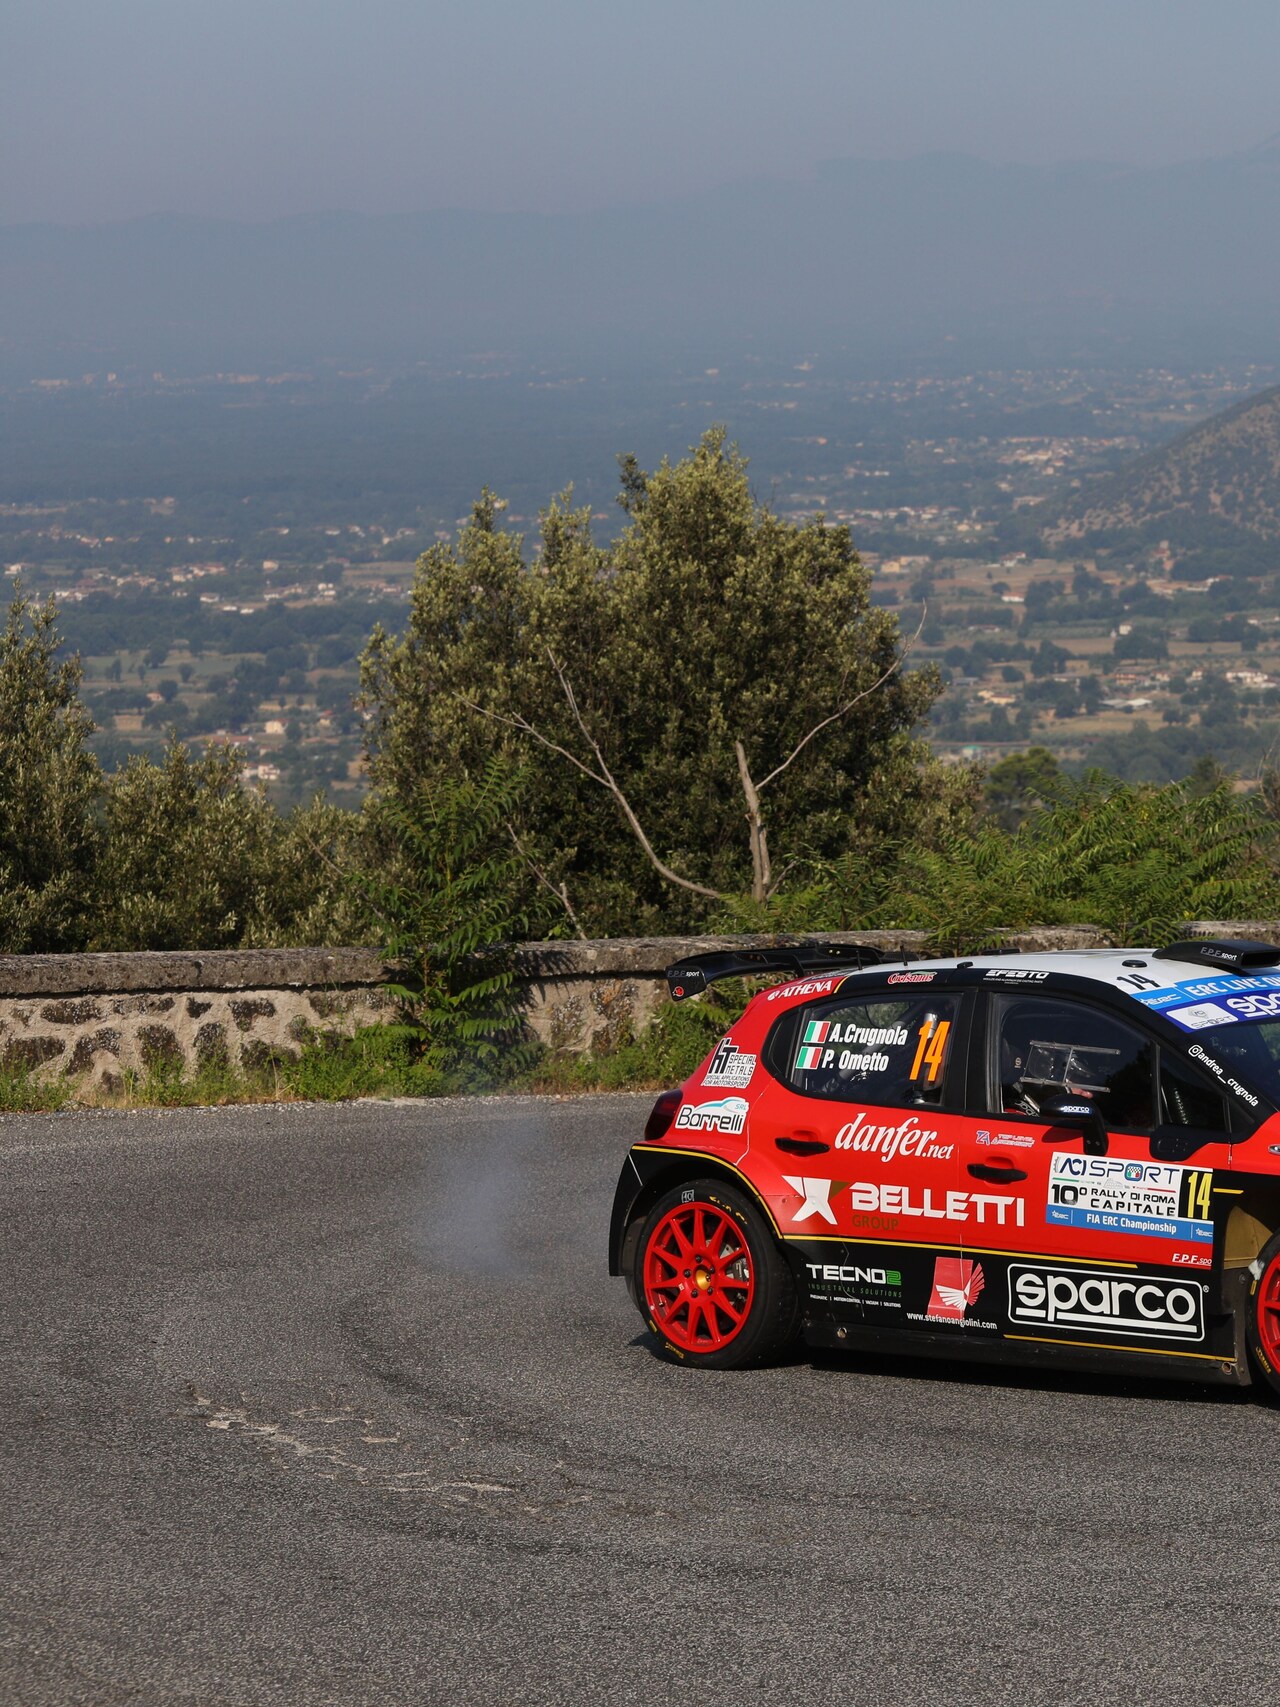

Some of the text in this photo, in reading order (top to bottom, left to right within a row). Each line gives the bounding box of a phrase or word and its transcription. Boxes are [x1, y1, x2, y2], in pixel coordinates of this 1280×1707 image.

[986, 969, 1050, 979] EFESTO
[1117, 974, 1160, 990] 14
[778, 981, 832, 998] ATHENA
[1184, 982, 1228, 996] ERC
[1221, 976, 1262, 991] LIVE
[829, 1023, 908, 1046] A.Crugnola
[822, 1049, 889, 1071] P. Ometto
[909, 1021, 951, 1082] 14
[677, 1107, 744, 1132] Borrelli
[835, 1112, 955, 1162] danfer.net
[849, 1182, 1025, 1227] BELLETTI
[1091, 1187, 1126, 1199] RALLY
[1130, 1191, 1140, 1200] DI
[1144, 1194, 1176, 1204] ROMA
[1187, 1171, 1213, 1219] 14
[1091, 1199, 1176, 1216] CAPITALE
[852, 1214, 899, 1230] GROUP
[1086, 1214, 1100, 1224] FIA
[1103, 1216, 1118, 1226] ERC
[1121, 1217, 1177, 1235] Championship
[806, 1263, 902, 1286] TECNO2
[808, 1283, 903, 1298] INDUSTRIAL SOLUTIONS
[1015, 1273, 1196, 1324] sparco
[906, 1312, 998, 1330] www.stefanoangiolini.com
